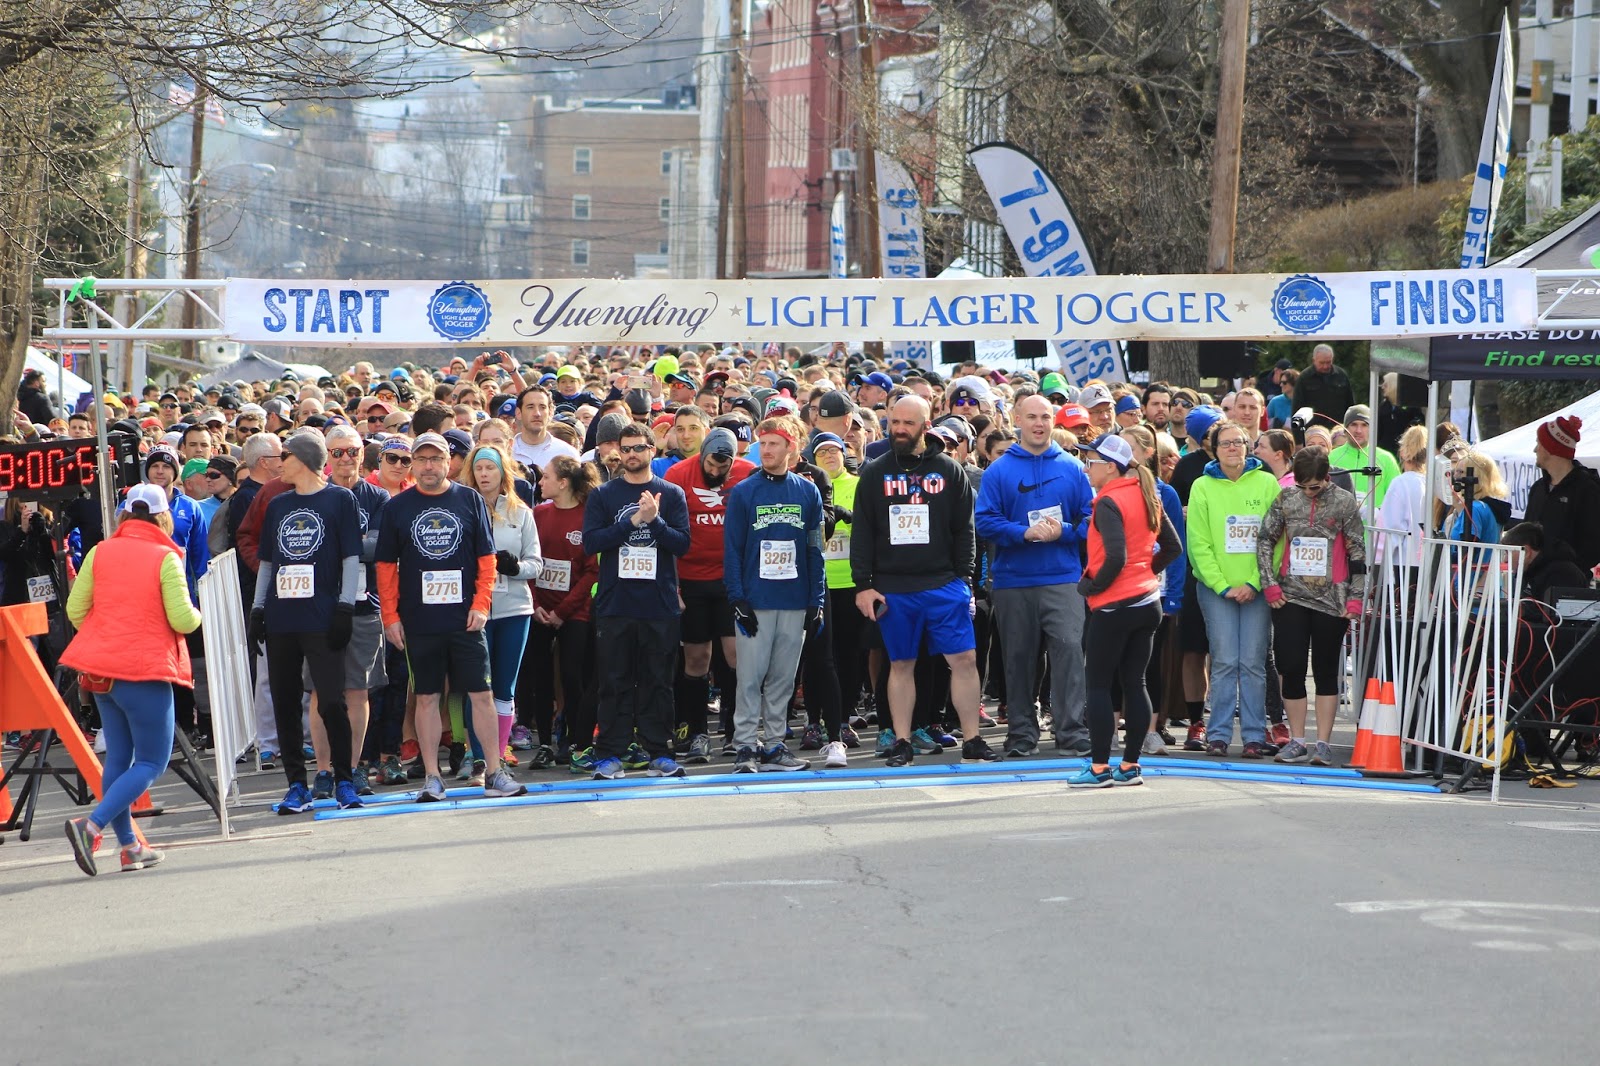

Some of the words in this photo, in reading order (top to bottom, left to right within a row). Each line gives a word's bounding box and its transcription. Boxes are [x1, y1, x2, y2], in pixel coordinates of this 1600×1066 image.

[1000, 169, 1068, 263] 7-9
[434, 301, 485, 316] Yuengling
[1278, 295, 1328, 310] Yuengling
[1370, 278, 1504, 326] FINISH
[263, 288, 389, 333] START
[513, 284, 718, 338] Yuengling
[746, 296, 876, 327] LIGHT
[892, 293, 1039, 327] LAGER
[1053, 291, 1233, 336] JOGGER
[1289, 314, 1319, 322] JOGGER
[444, 320, 474, 328] JOGGER
[1484, 350, 1546, 367] Find
[897, 515, 922, 529] 374
[282, 525, 319, 537] Yuengling
[417, 524, 457, 536] Yuengling
[1228, 525, 1259, 538] 3573
[764, 551, 793, 565] 3261
[1294, 547, 1324, 561] 1230
[622, 557, 653, 572] 2155
[280, 575, 310, 591] 2178
[538, 567, 567, 584] 2072
[426, 581, 459, 596] 2776
